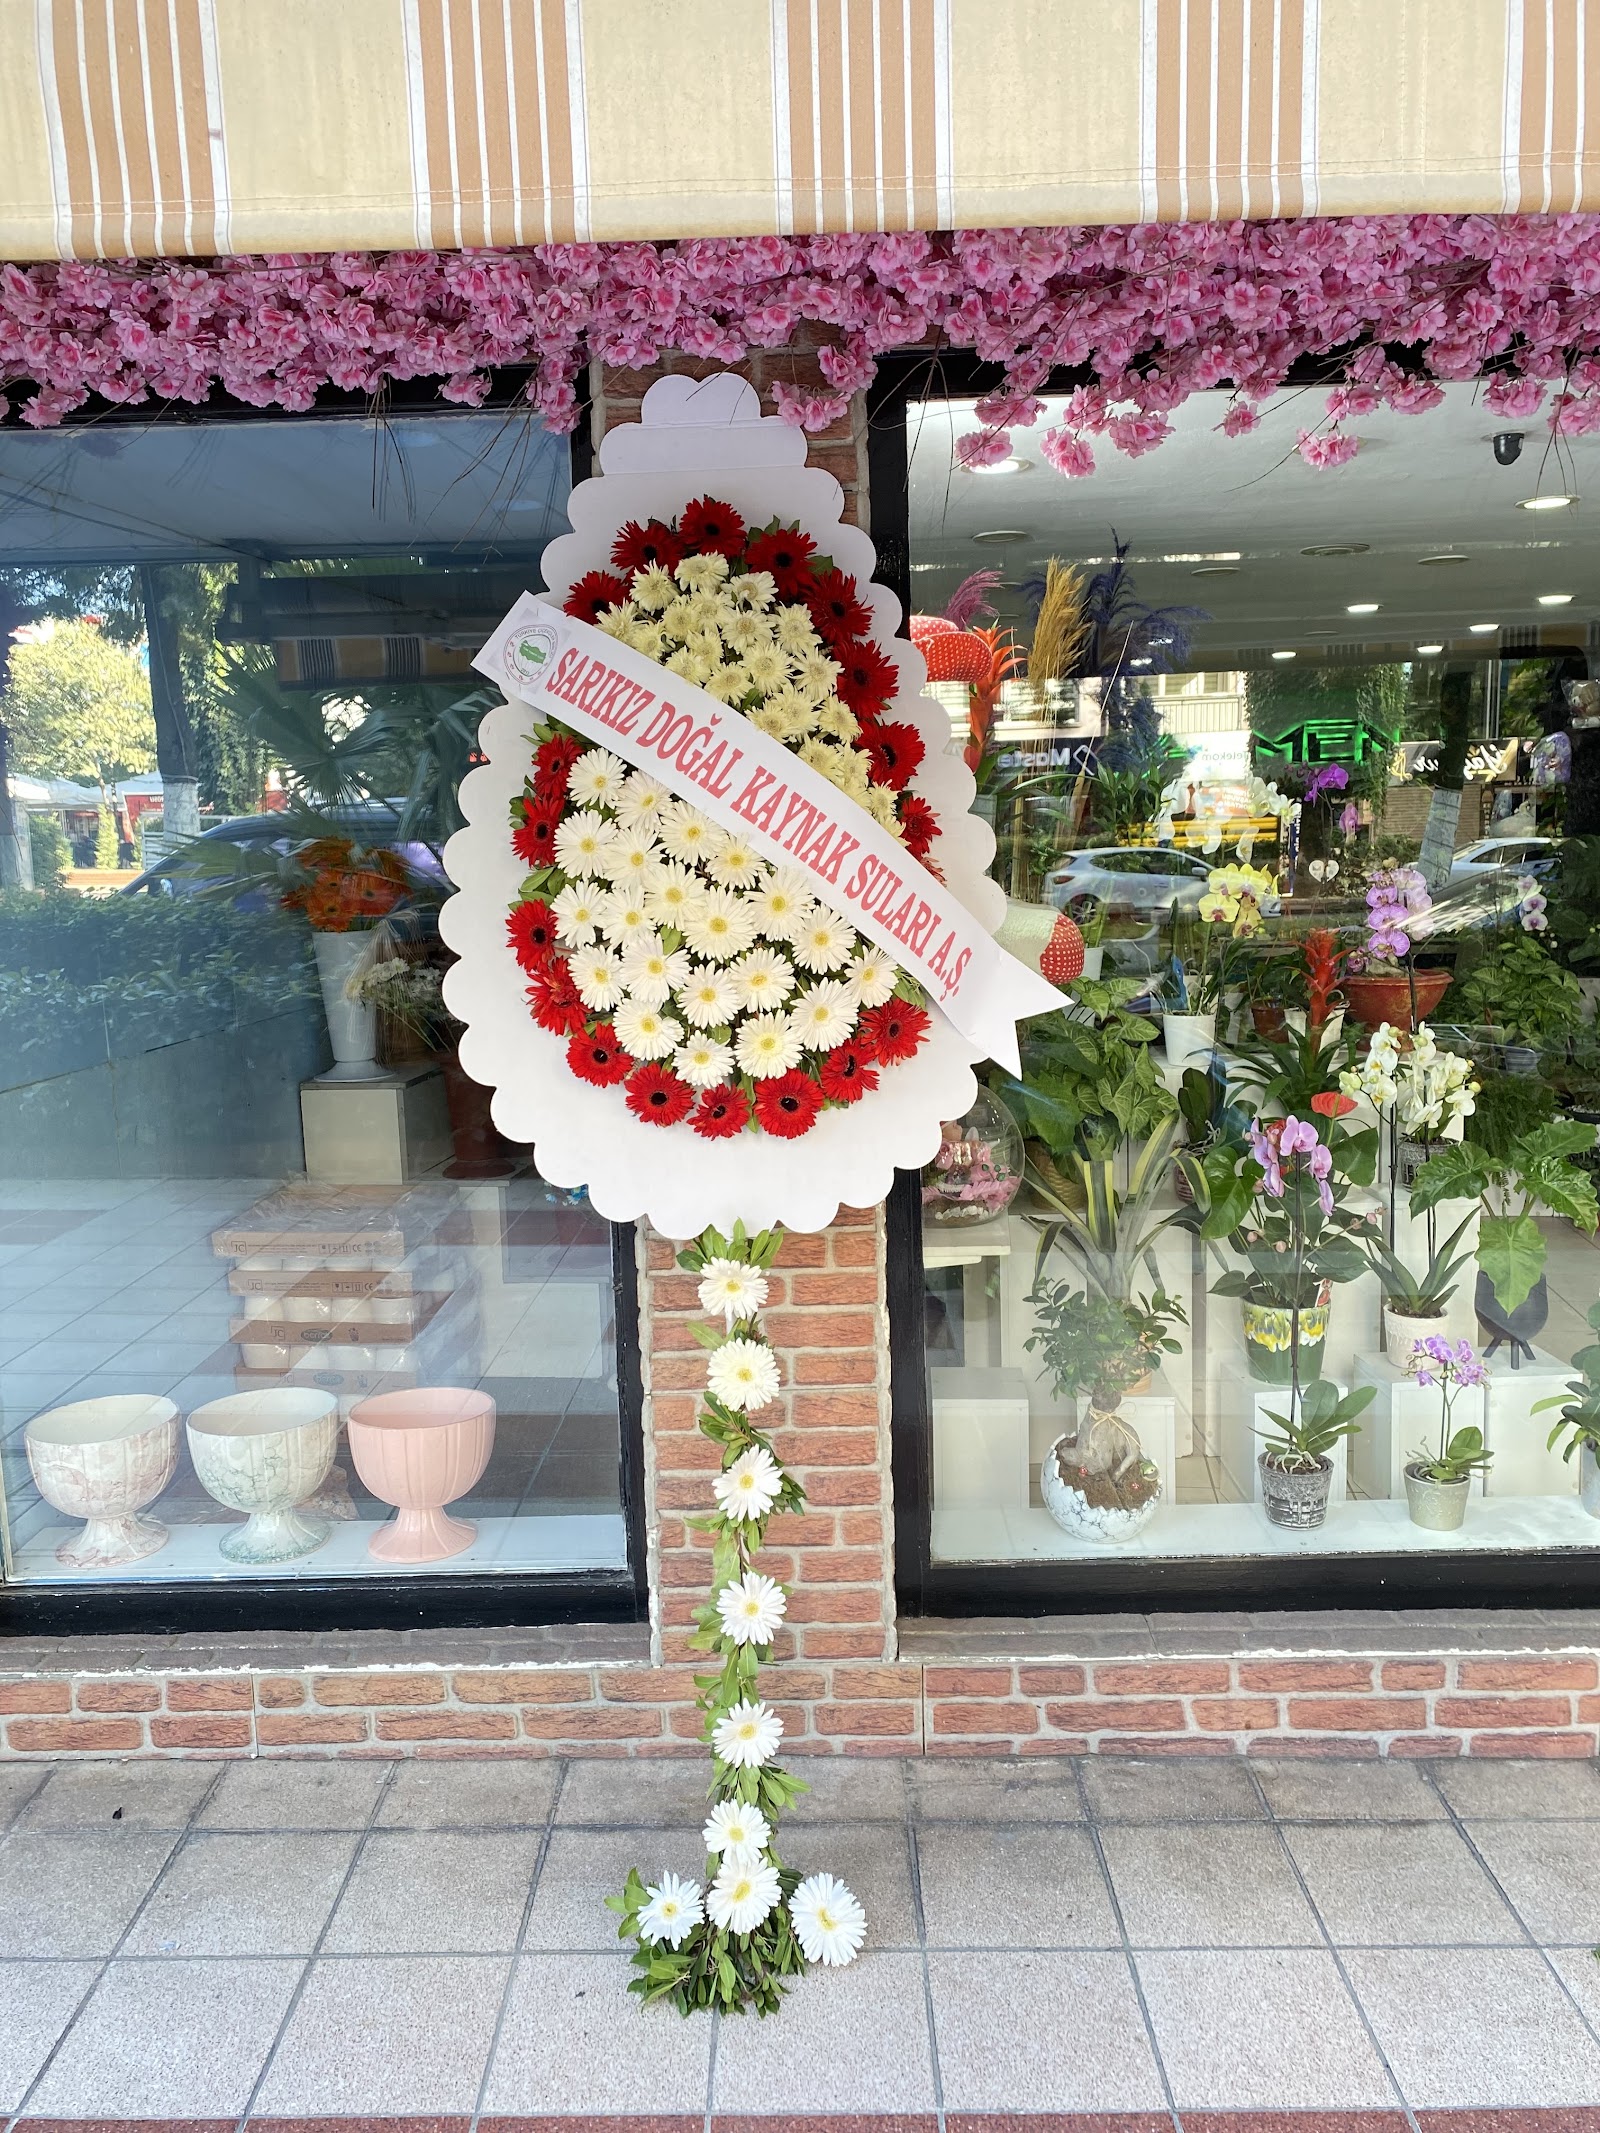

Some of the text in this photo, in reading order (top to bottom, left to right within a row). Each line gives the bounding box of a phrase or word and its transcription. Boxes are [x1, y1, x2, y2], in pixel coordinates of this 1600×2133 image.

[545, 647, 972, 1001] SARIKIZ DOĞAL KAYNAK SULARI A.Ş.
